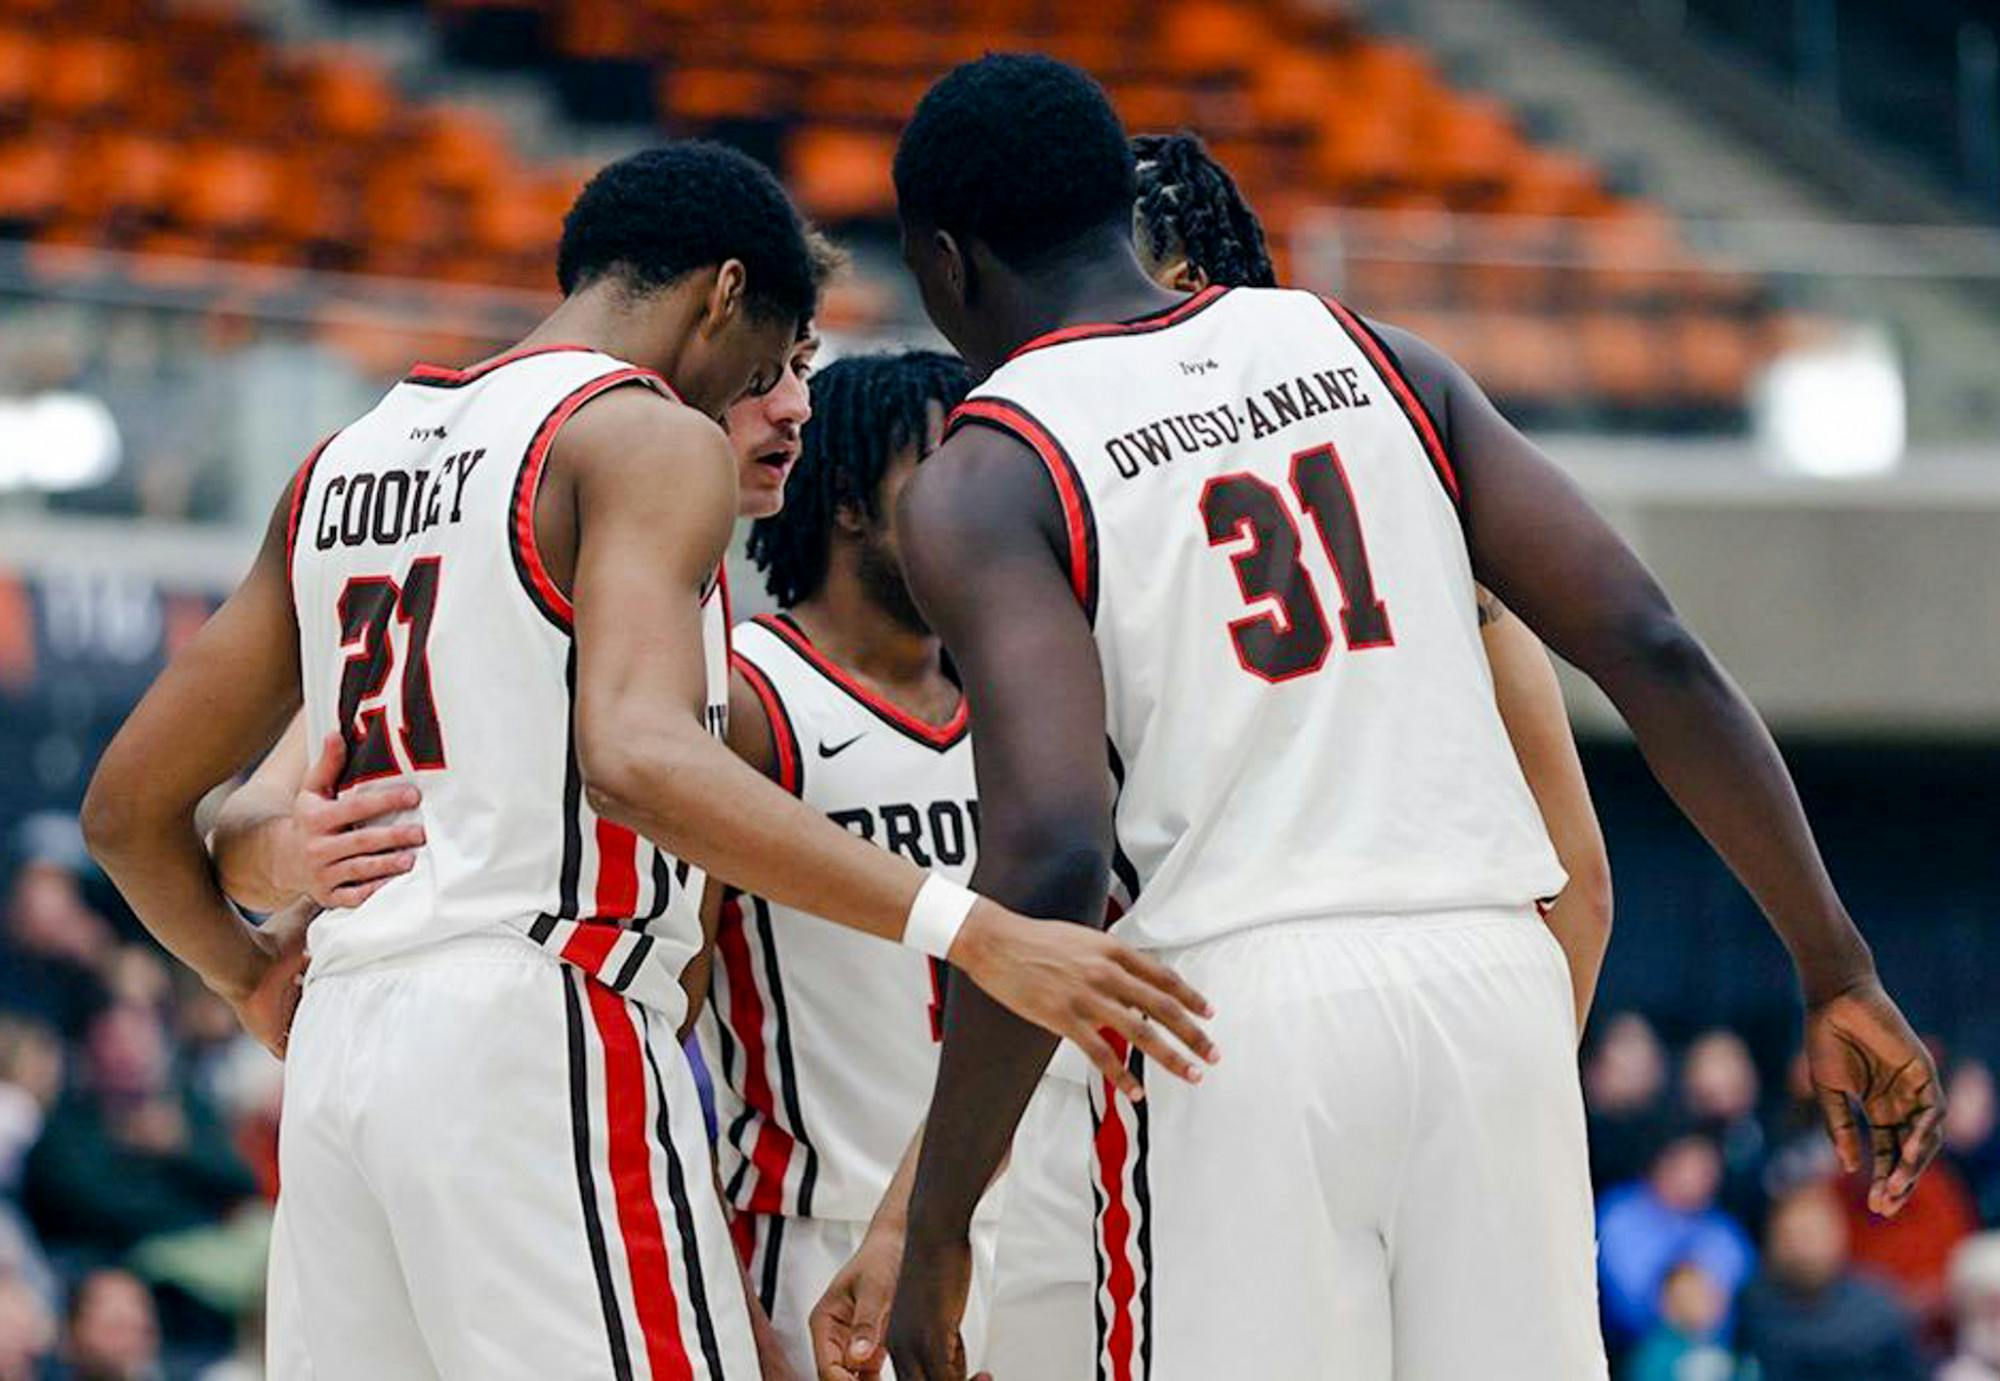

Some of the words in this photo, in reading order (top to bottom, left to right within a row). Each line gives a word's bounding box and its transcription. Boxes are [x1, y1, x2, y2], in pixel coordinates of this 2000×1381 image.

[1104, 367, 1371, 480] OWUSU-ANANE
[336, 555, 447, 792] 21
[1198, 441, 1396, 684] 31
